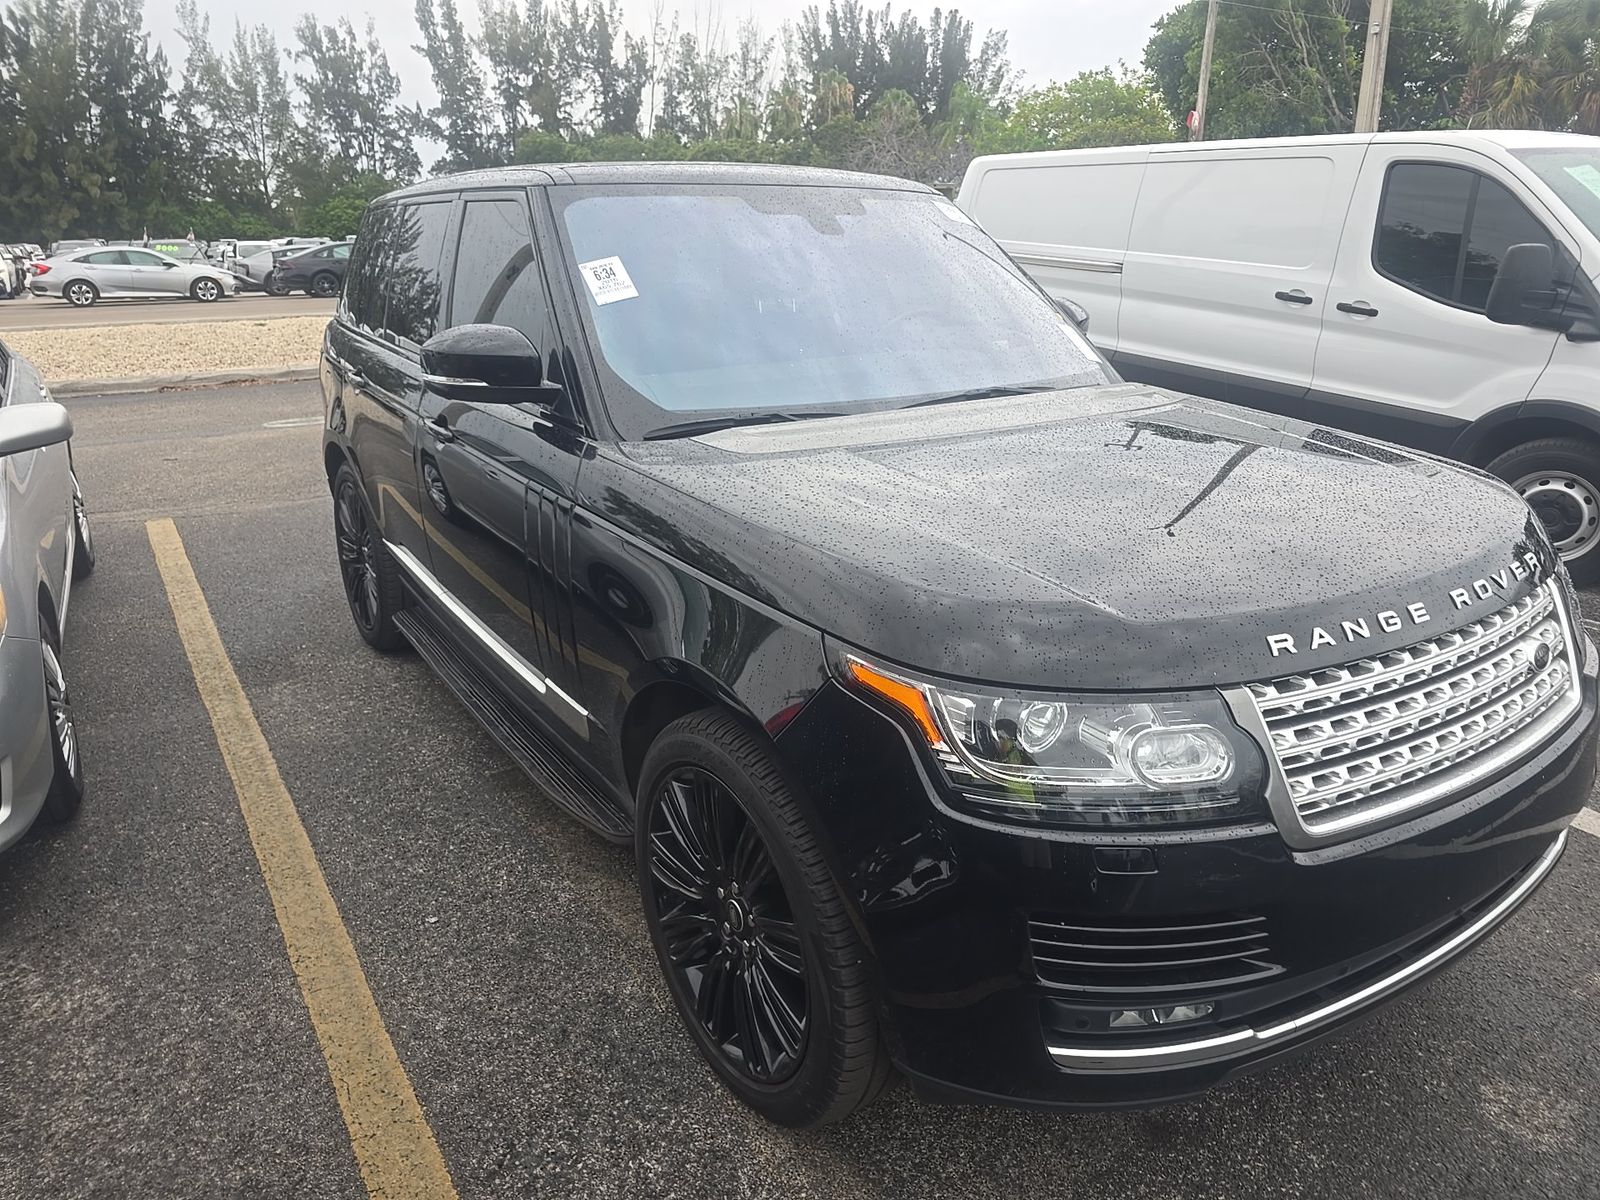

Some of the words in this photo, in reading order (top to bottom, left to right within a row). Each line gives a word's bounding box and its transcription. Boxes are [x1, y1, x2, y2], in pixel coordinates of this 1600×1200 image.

[593, 266, 616, 281] 6:34
[1265, 601, 1431, 657] RANGE
[1448, 551, 1543, 610] ROVER
